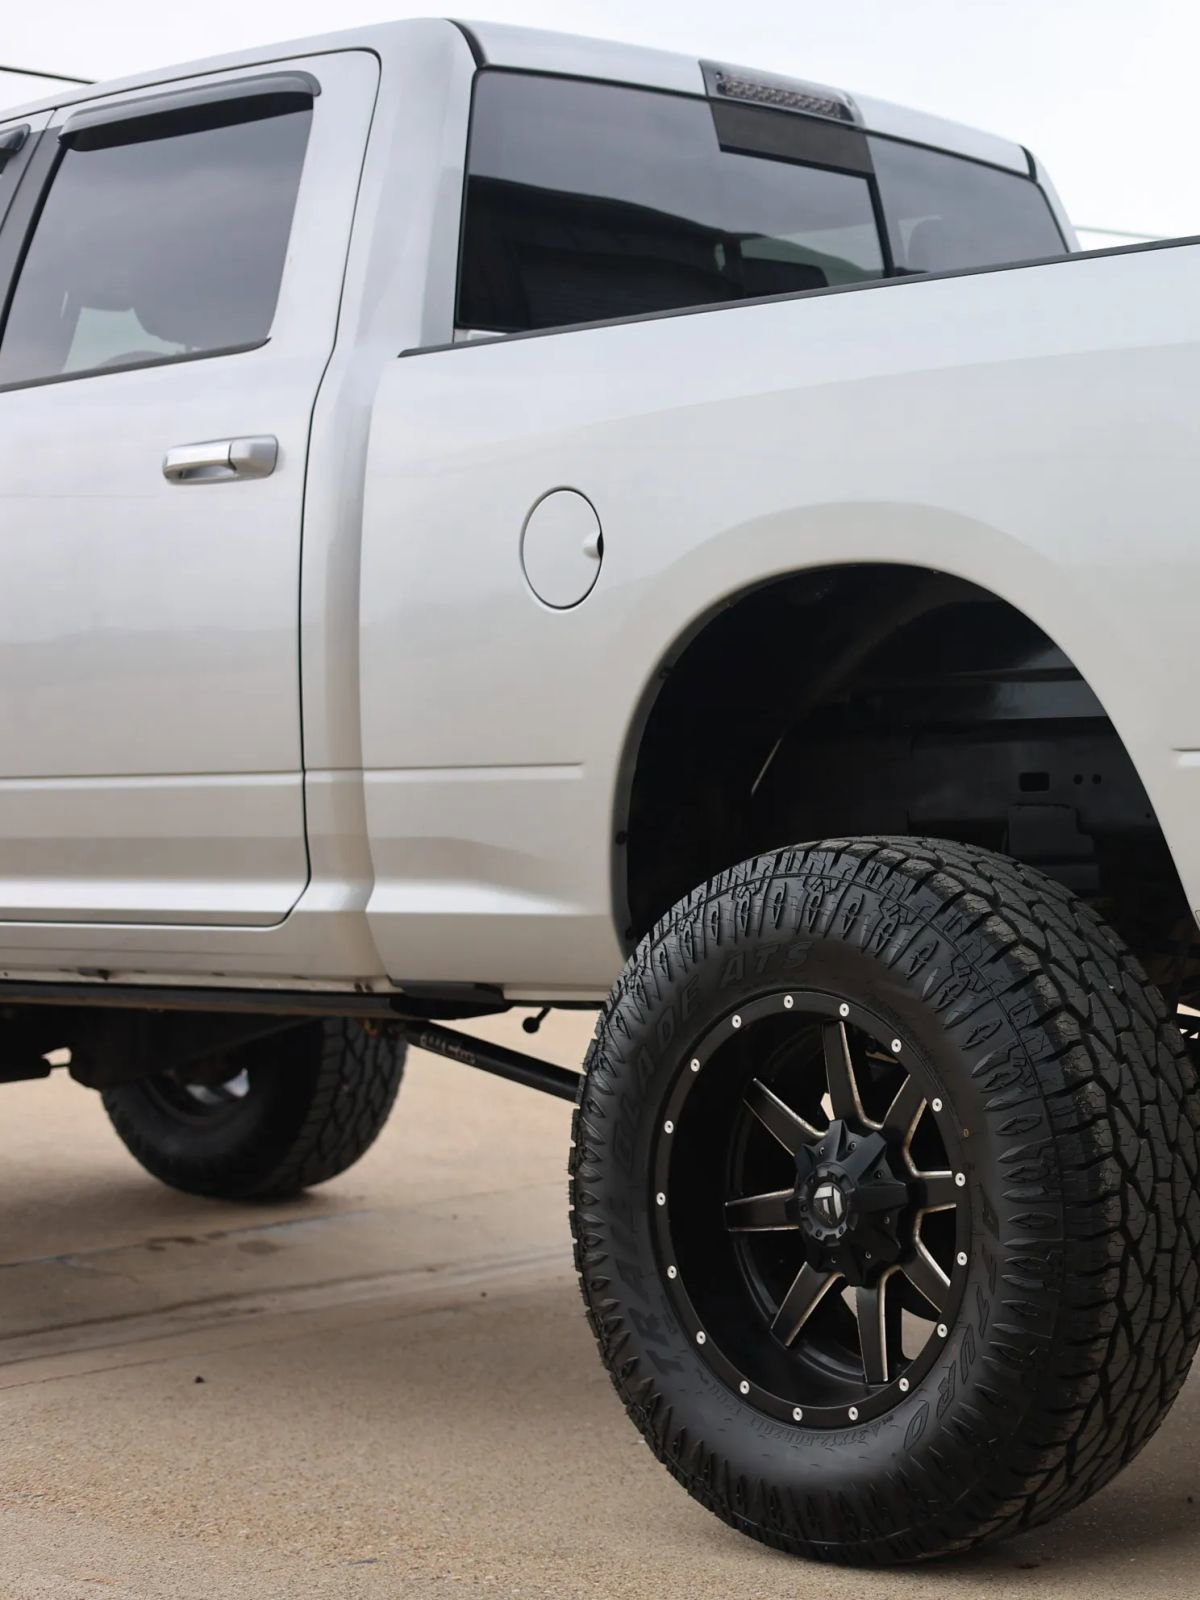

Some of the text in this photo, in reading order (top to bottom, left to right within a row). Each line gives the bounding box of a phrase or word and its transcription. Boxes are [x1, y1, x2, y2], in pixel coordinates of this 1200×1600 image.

[613, 974, 699, 1183] BLADE
[719, 941, 815, 990] ATS
[903, 1180, 1000, 1451] ATTURO
